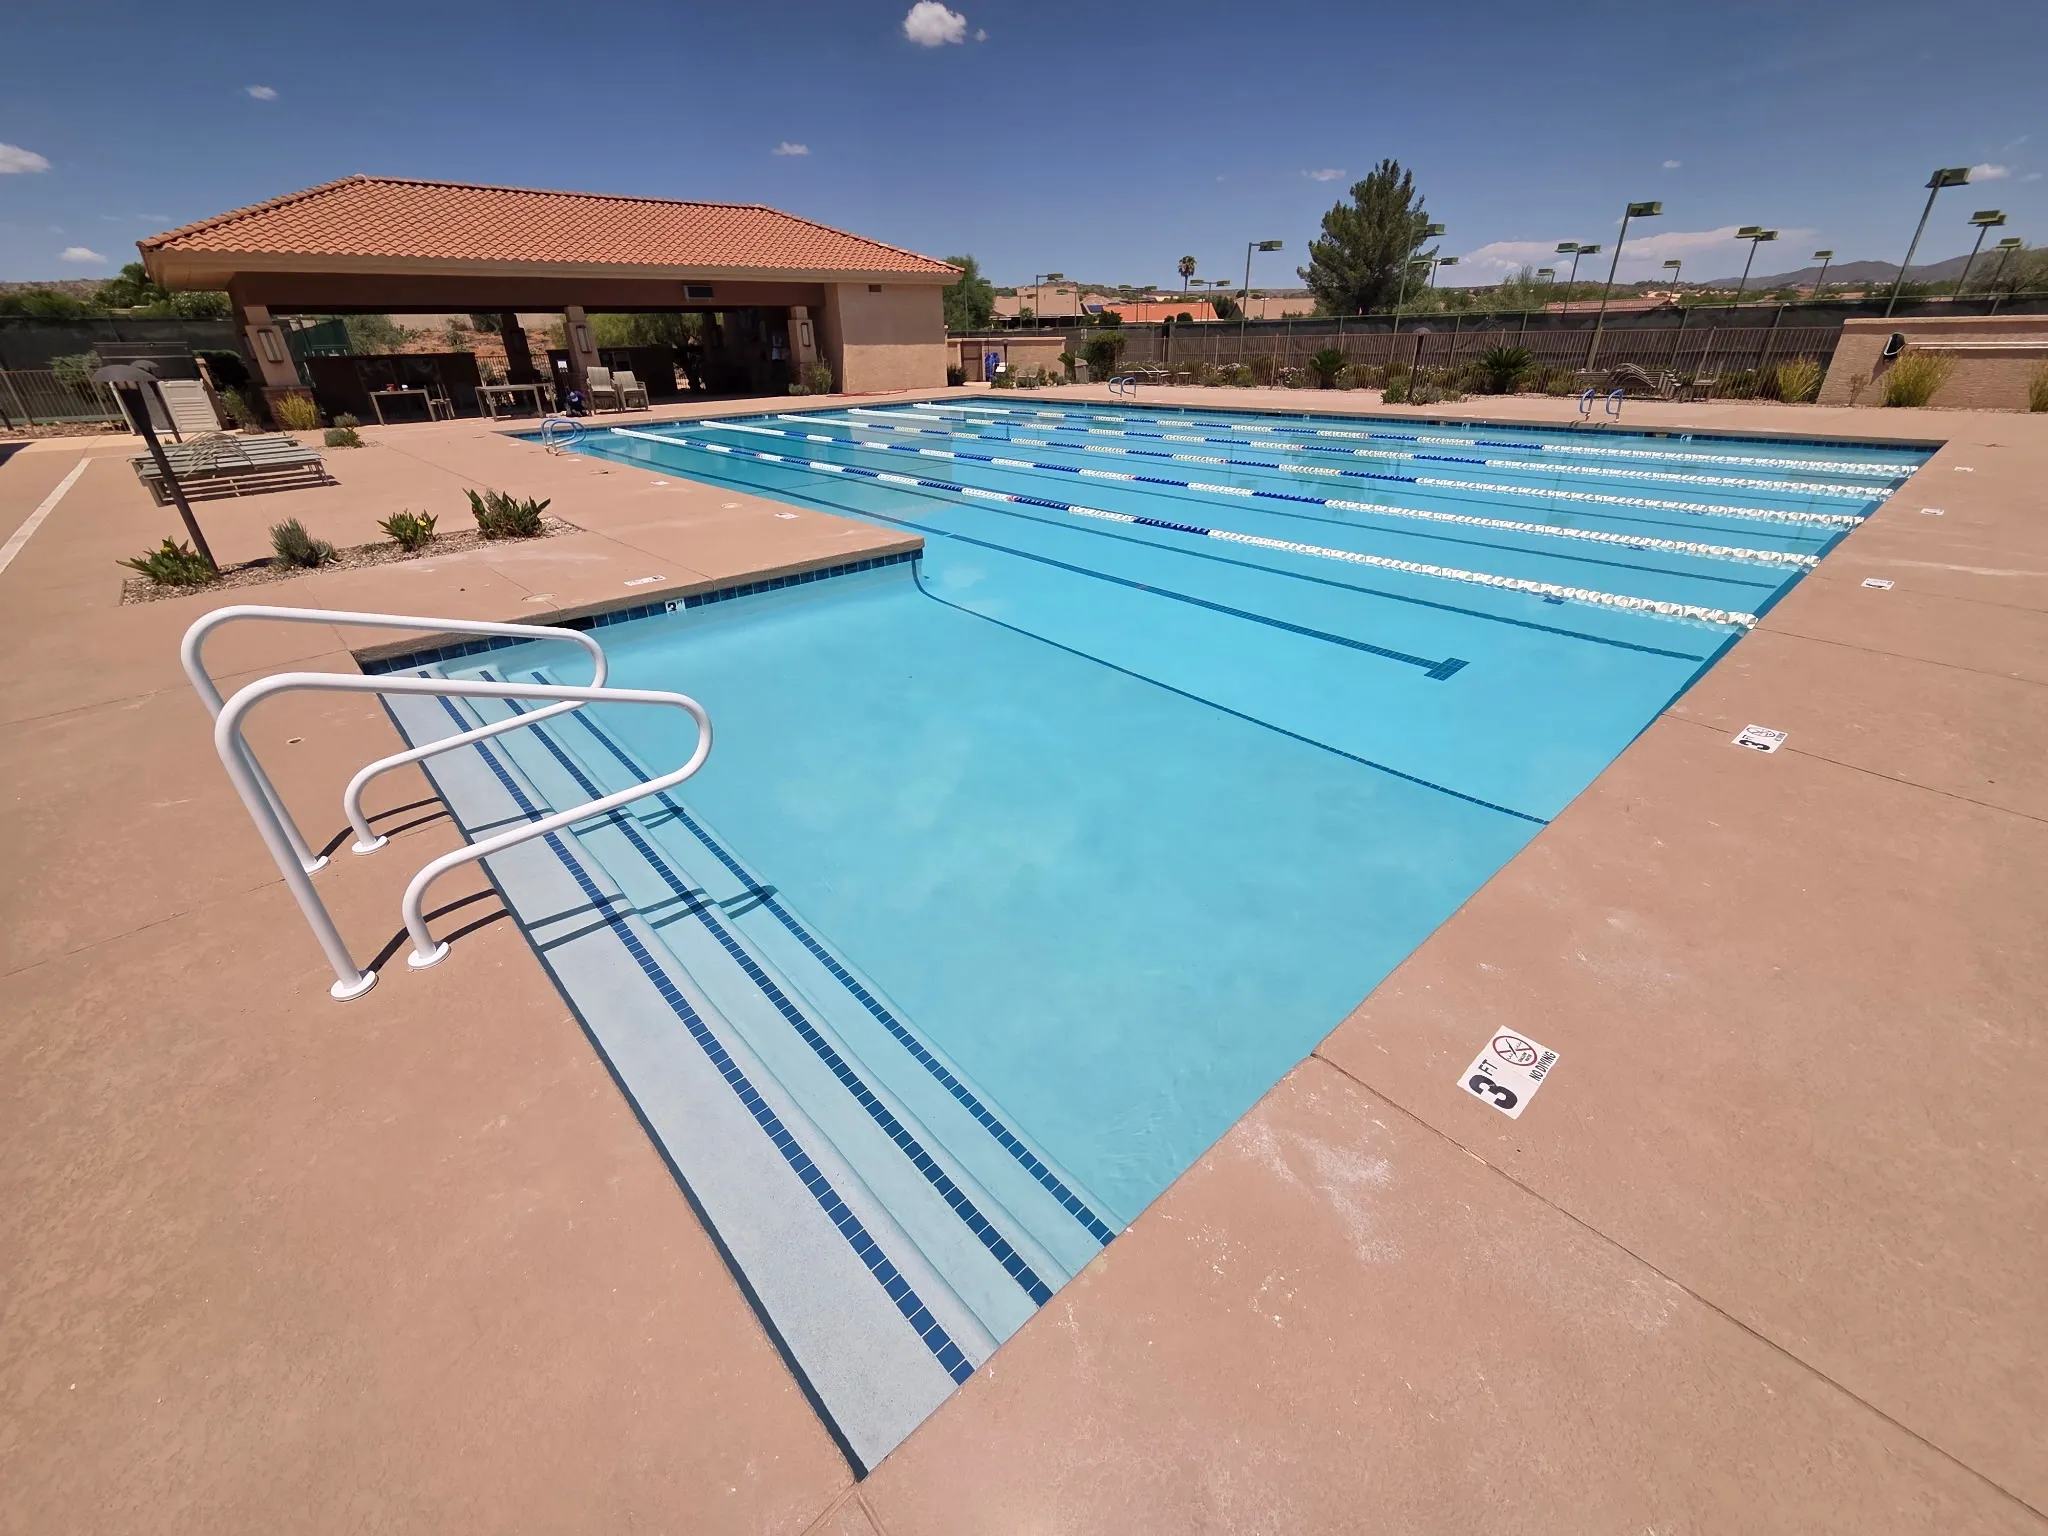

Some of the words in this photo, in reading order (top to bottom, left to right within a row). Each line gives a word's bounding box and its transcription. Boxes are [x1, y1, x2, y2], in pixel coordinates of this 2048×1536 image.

[1739, 739, 1770, 750] 3
[1478, 1059, 1498, 1076] FT
[1535, 1051, 1556, 1073] DIVING
[1529, 1069, 1544, 1081] NO
[1469, 1074, 1518, 1110] 3
